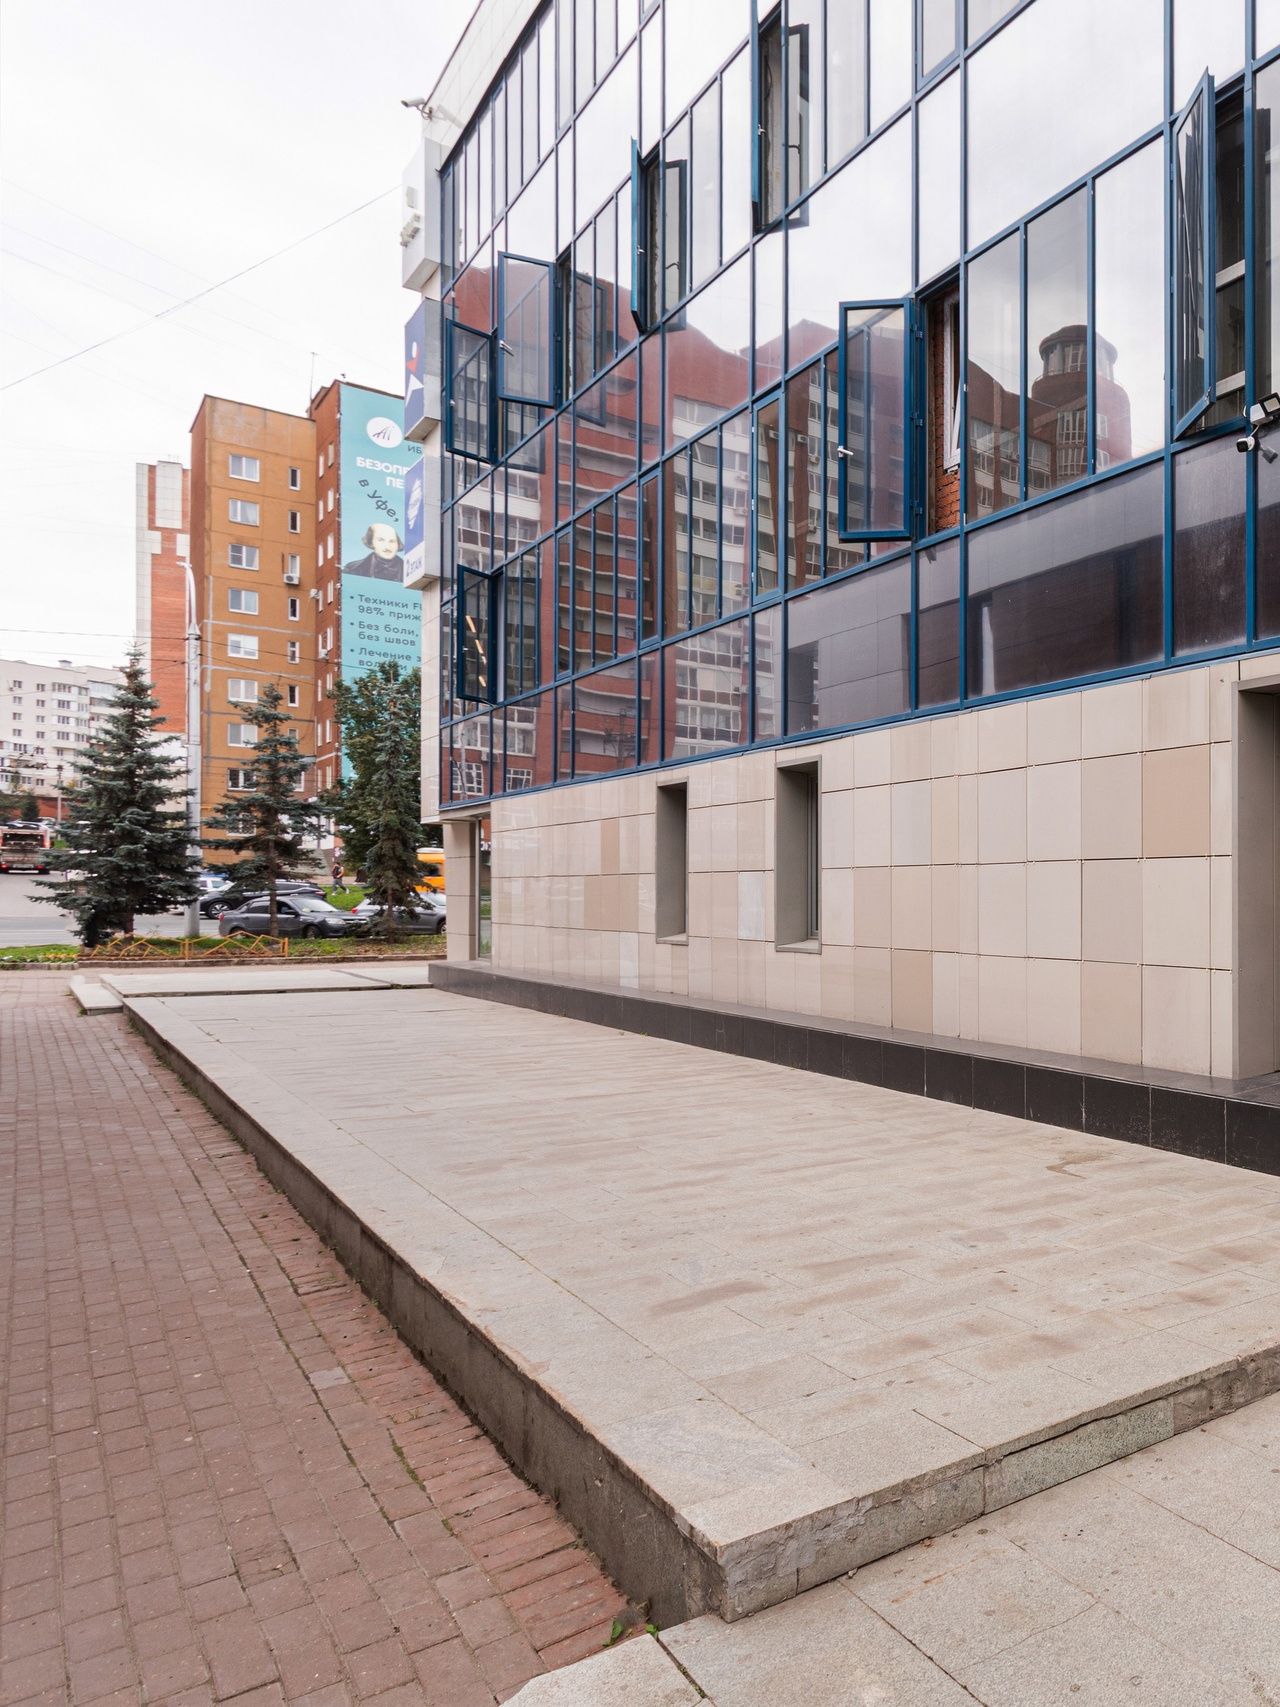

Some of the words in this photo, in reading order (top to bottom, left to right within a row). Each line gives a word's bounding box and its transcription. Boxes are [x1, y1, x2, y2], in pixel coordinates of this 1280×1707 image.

[386, 476, 404, 489] ПЕ
[358, 594, 408, 609] Техники
[358, 605, 385, 616] 98%
[389, 611, 422, 622] приж
[358, 621, 380, 631] Без
[384, 624, 419, 638] боли,
[358, 631, 380, 641] без
[384, 636, 416, 647] швов
[358, 647, 412, 661] Лечение
